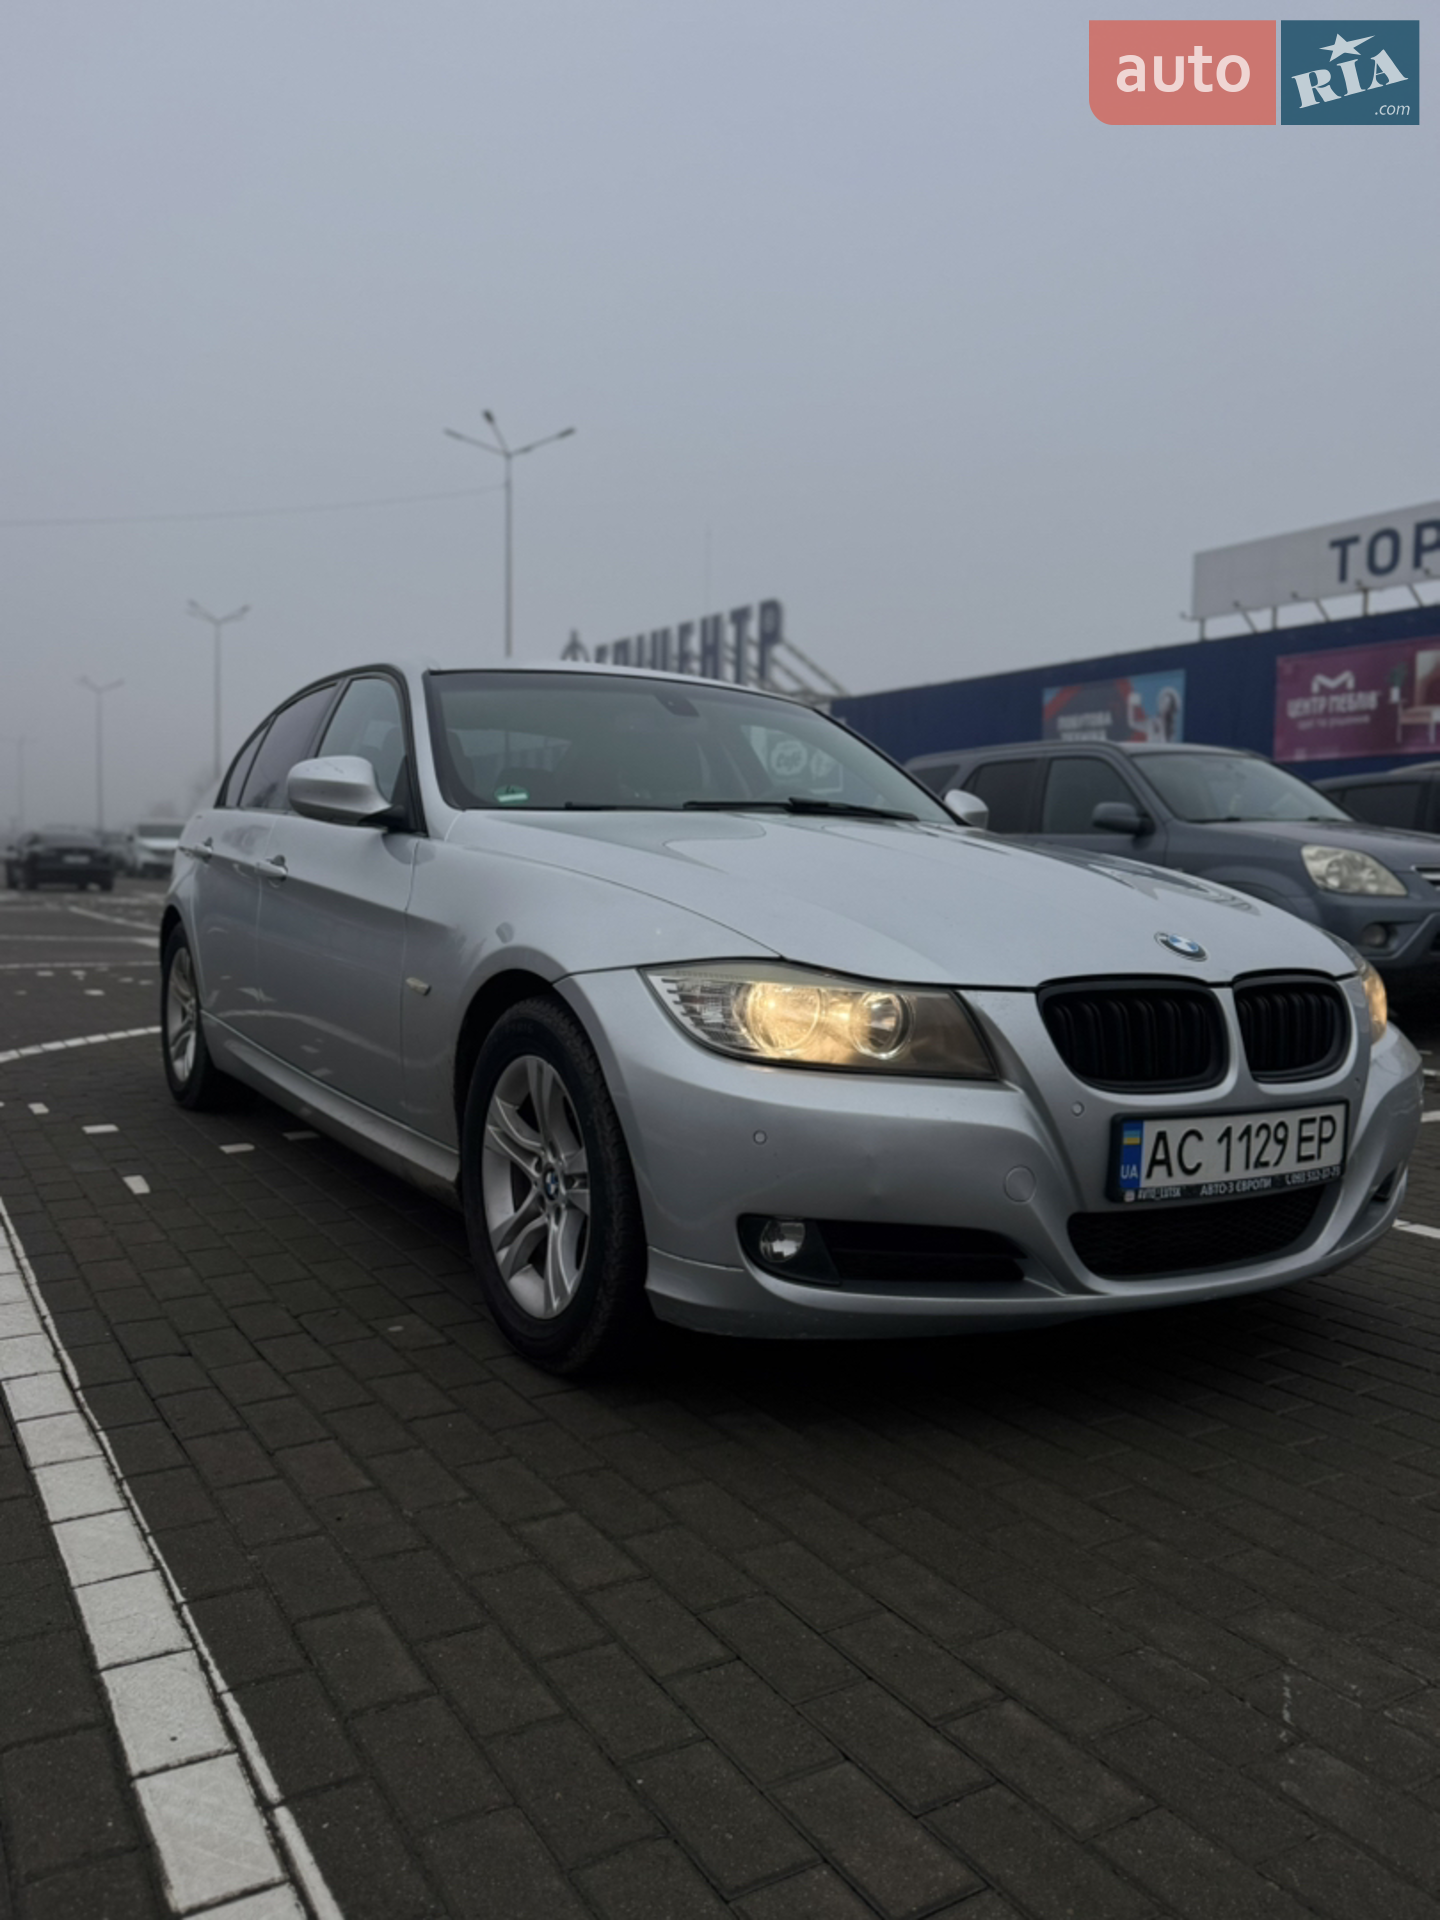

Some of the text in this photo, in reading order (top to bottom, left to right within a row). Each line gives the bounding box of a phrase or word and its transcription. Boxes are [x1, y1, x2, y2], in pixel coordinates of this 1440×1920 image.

[1146, 1114, 1337, 1180] AC 1129 EP
[1121, 1164, 1139, 1180] UA
